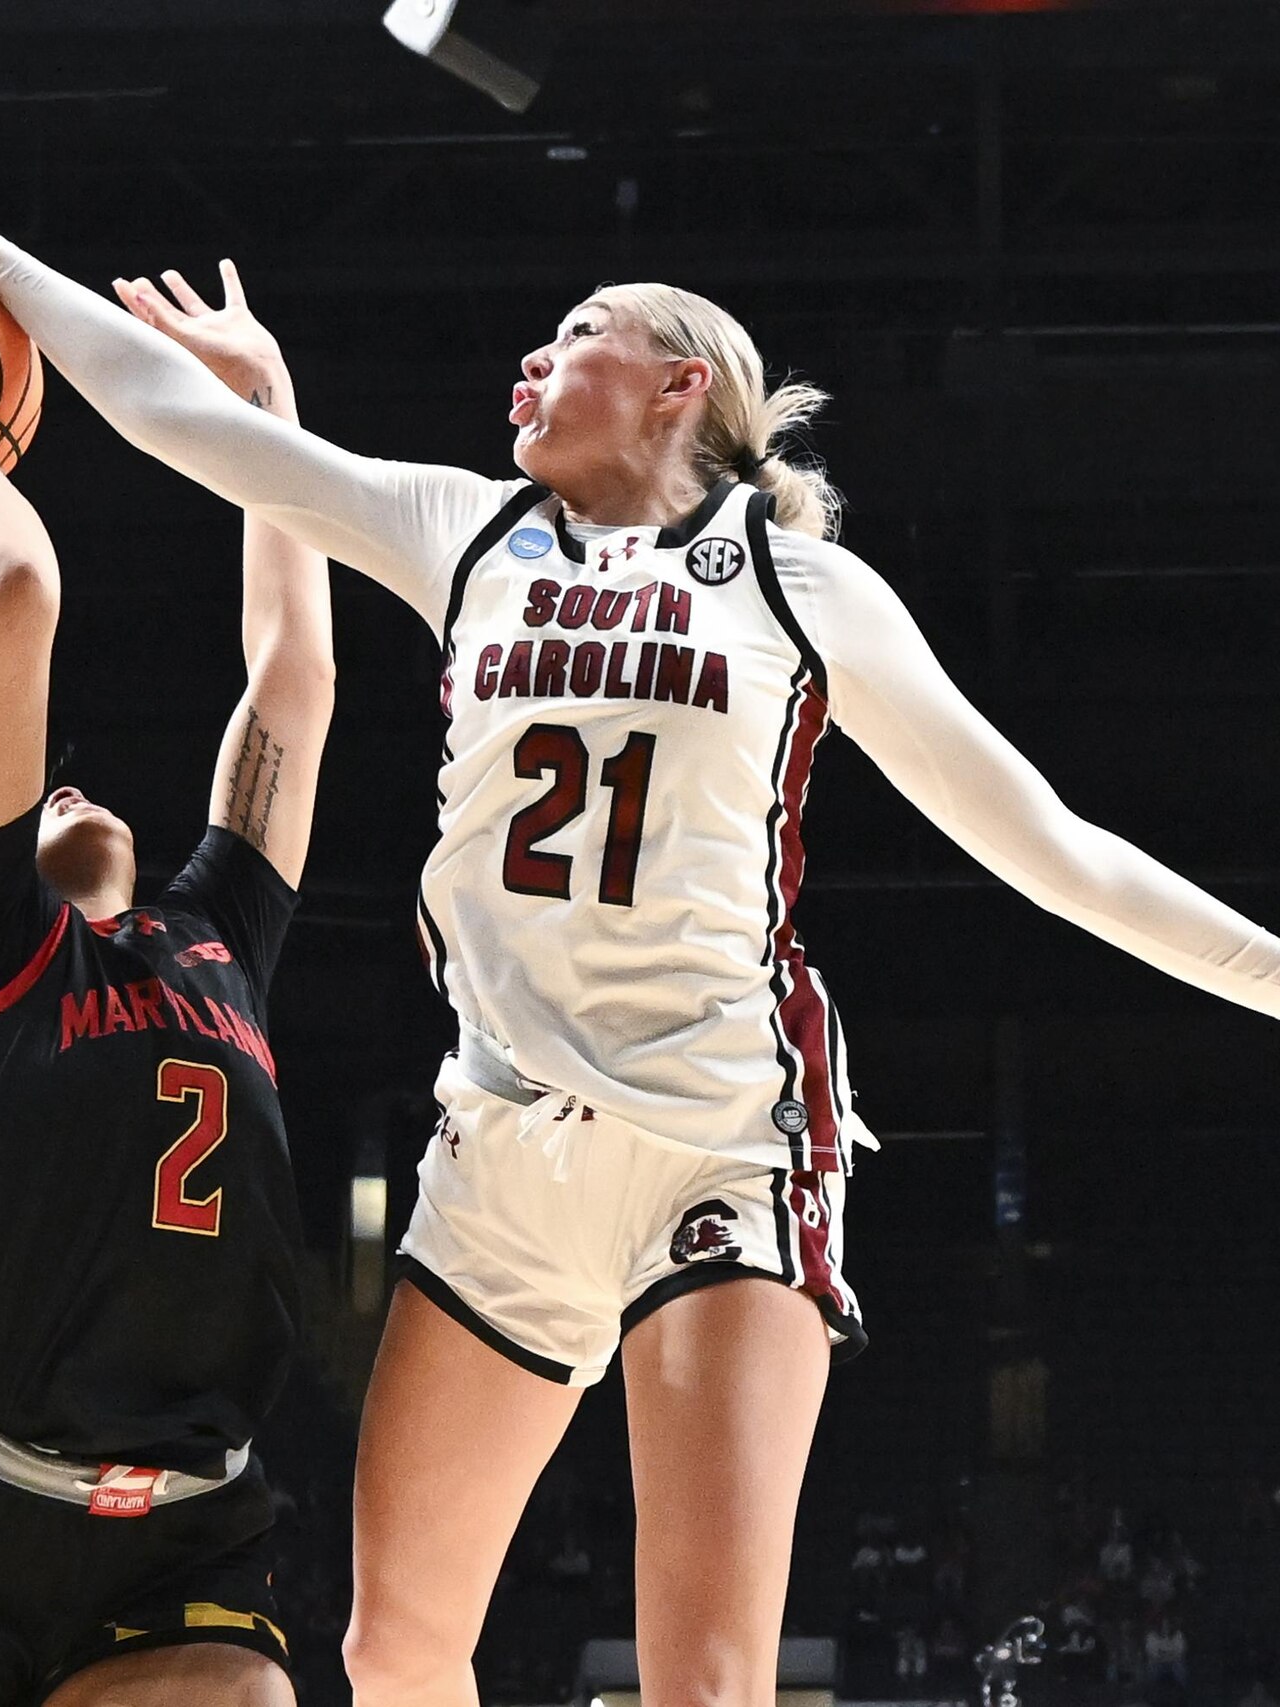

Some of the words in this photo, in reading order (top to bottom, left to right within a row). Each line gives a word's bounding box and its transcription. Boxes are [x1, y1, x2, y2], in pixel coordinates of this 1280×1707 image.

[692, 539, 739, 581] SEC
[523, 578, 691, 635] SOUTH
[473, 640, 728, 714] CAROLINA
[502, 722, 657, 908] 21
[152, 1057, 228, 1237] 2
[96, 1494, 146, 1509] MARYLAND
